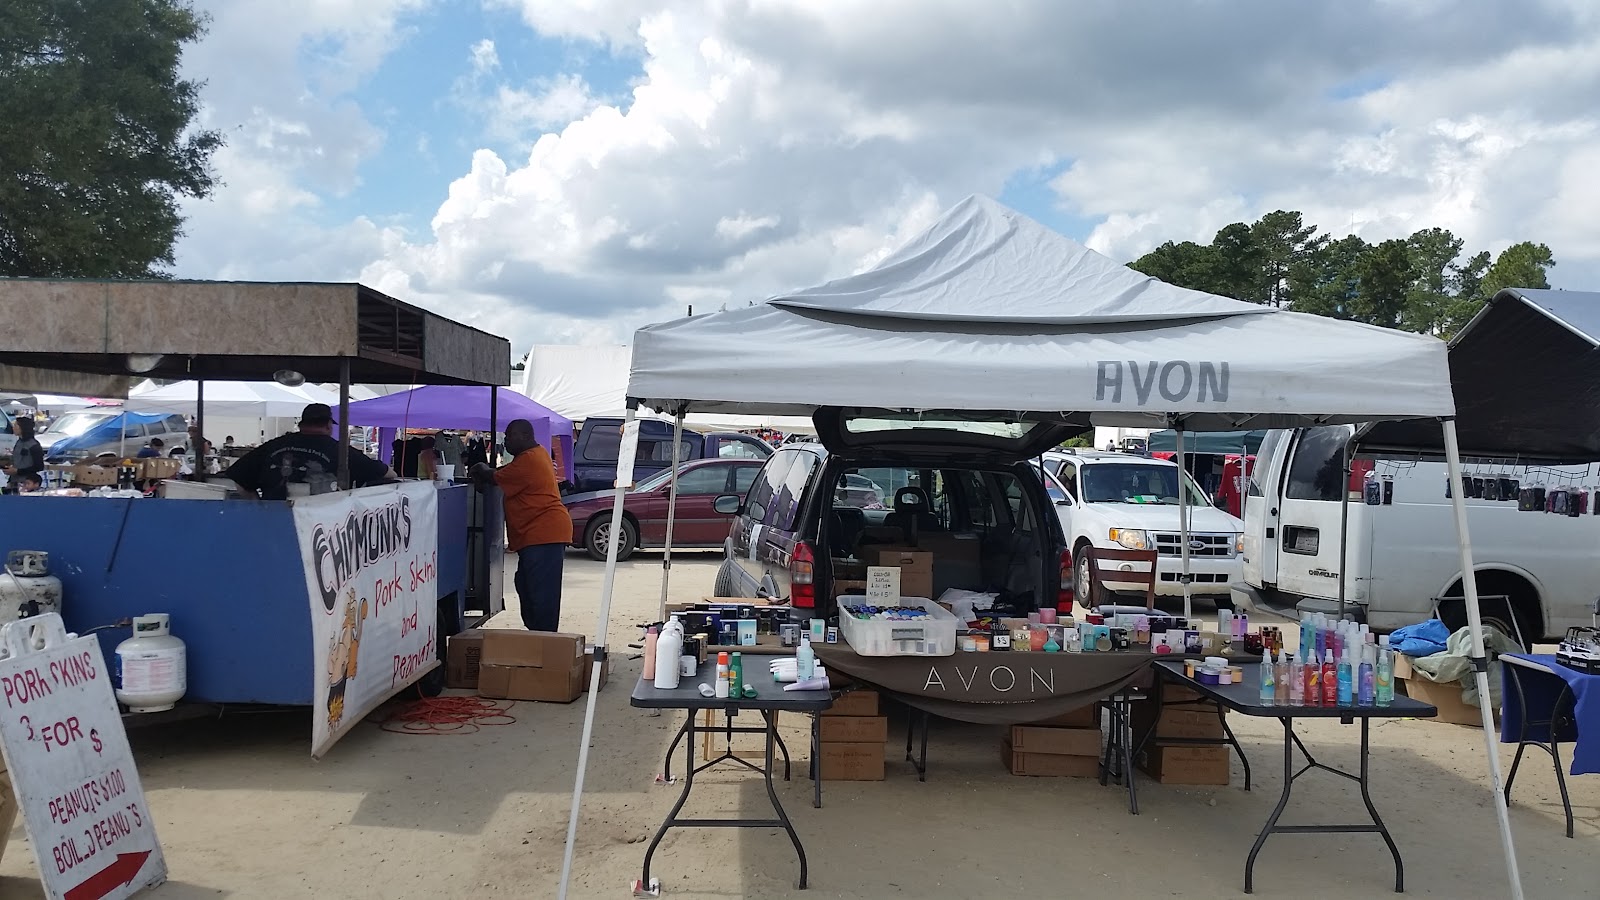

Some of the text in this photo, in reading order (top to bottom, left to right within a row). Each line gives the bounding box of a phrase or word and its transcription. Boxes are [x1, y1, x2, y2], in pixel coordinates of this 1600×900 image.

[1095, 360, 1230, 406] AVON
[375, 550, 436, 619] Pork Skins
[401, 600, 418, 638] and
[1, 667, 52, 709] PORK
[49, 651, 96, 688] SKINS
[923, 665, 1055, 694] AVON
[41, 716, 84, 753] FOR
[48, 780, 101, 825] PEANUTS
[53, 803, 142, 874] BOILD PEANUS
